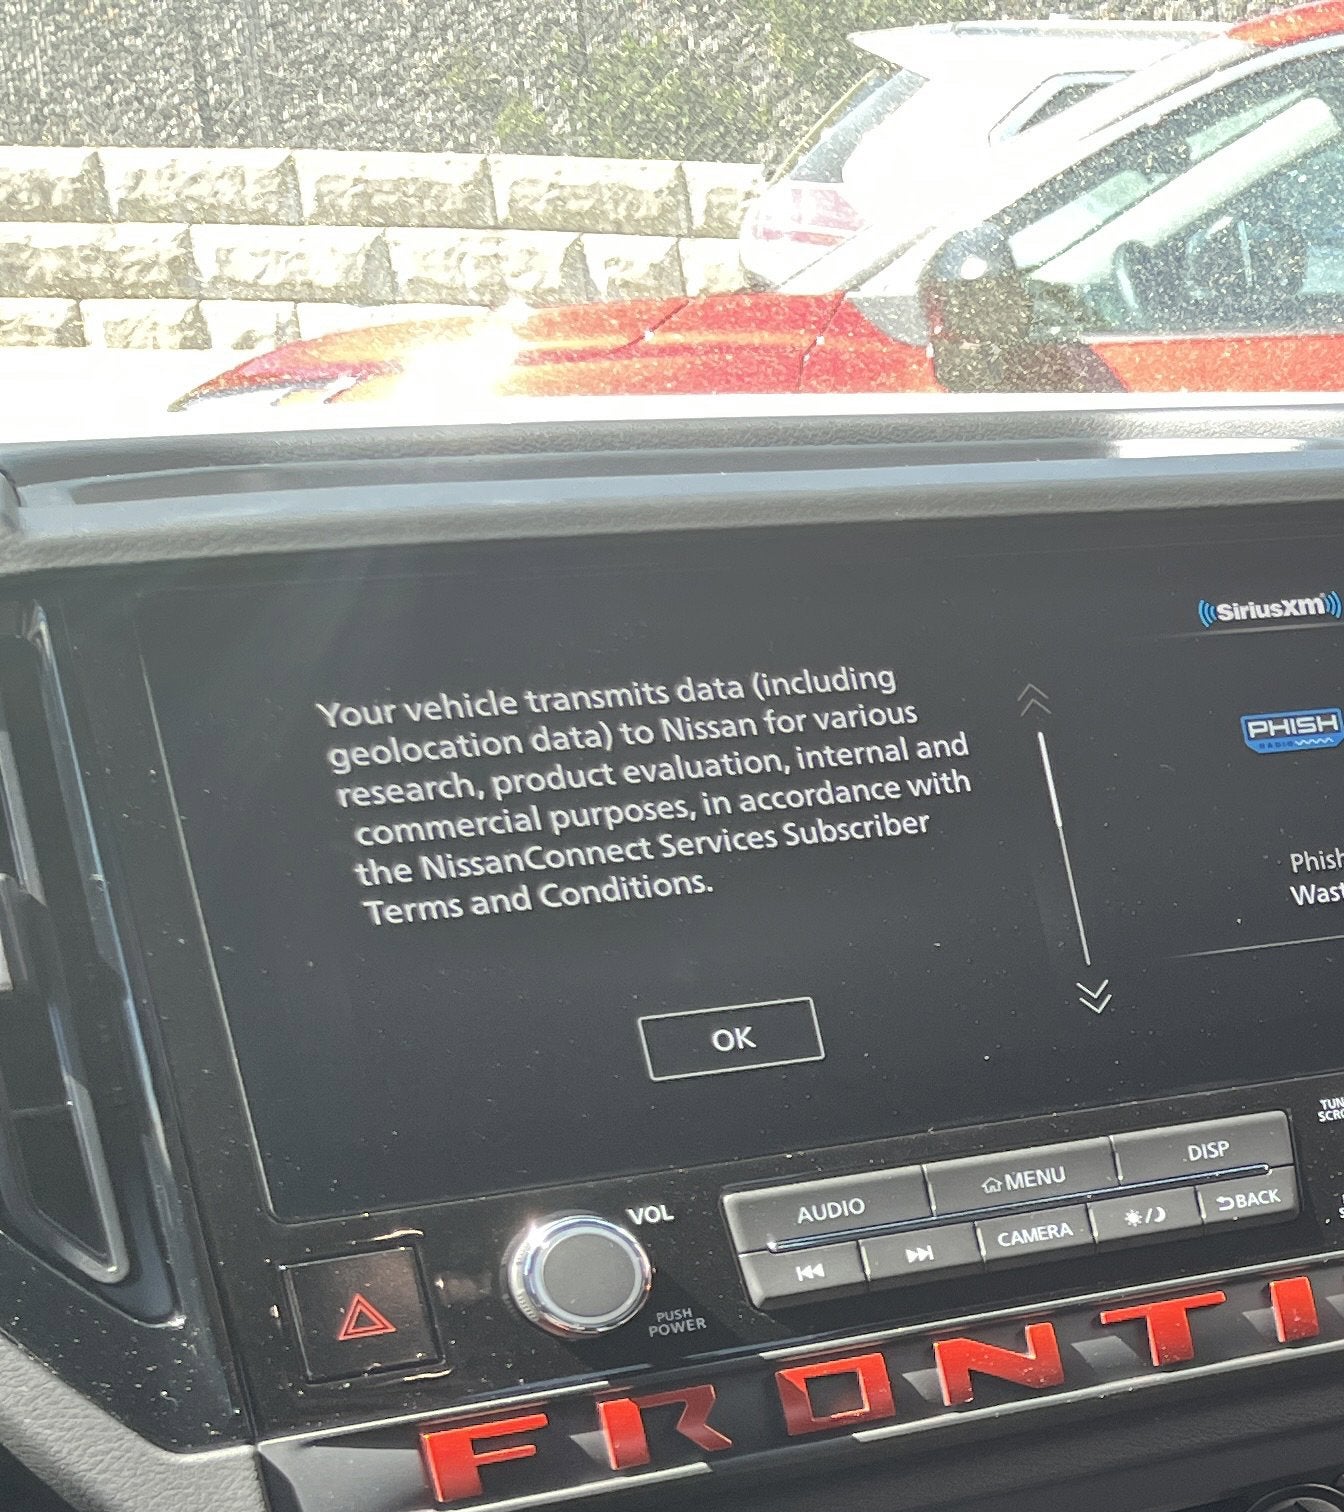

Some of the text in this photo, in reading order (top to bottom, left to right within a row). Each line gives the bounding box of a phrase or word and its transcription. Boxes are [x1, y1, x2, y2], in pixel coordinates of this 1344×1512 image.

[316, 666, 897, 729] Your vehicle transmits data (including
[327, 703, 919, 775] geolocation data) to Nissan for various
[1247, 714, 1340, 739] PHISH
[336, 731, 970, 808] research, product evaluation, internal and
[355, 768, 973, 846] commercial purposes, in accordance with
[353, 811, 931, 887] the NissanConnect Services Subscriber
[363, 872, 715, 926] Terms and Conditions.
[711, 1024, 758, 1054] OK
[1187, 1140, 1231, 1163] DISP
[1004, 1165, 1068, 1192] MENU
[797, 1197, 866, 1224] AUDIO
[1234, 1187, 1283, 1210] BACK
[626, 1204, 675, 1227] VOL
[997, 1222, 1074, 1249] CAMERA
[648, 1318, 707, 1338] POWER
[655, 1307, 693, 1323] PUSH
